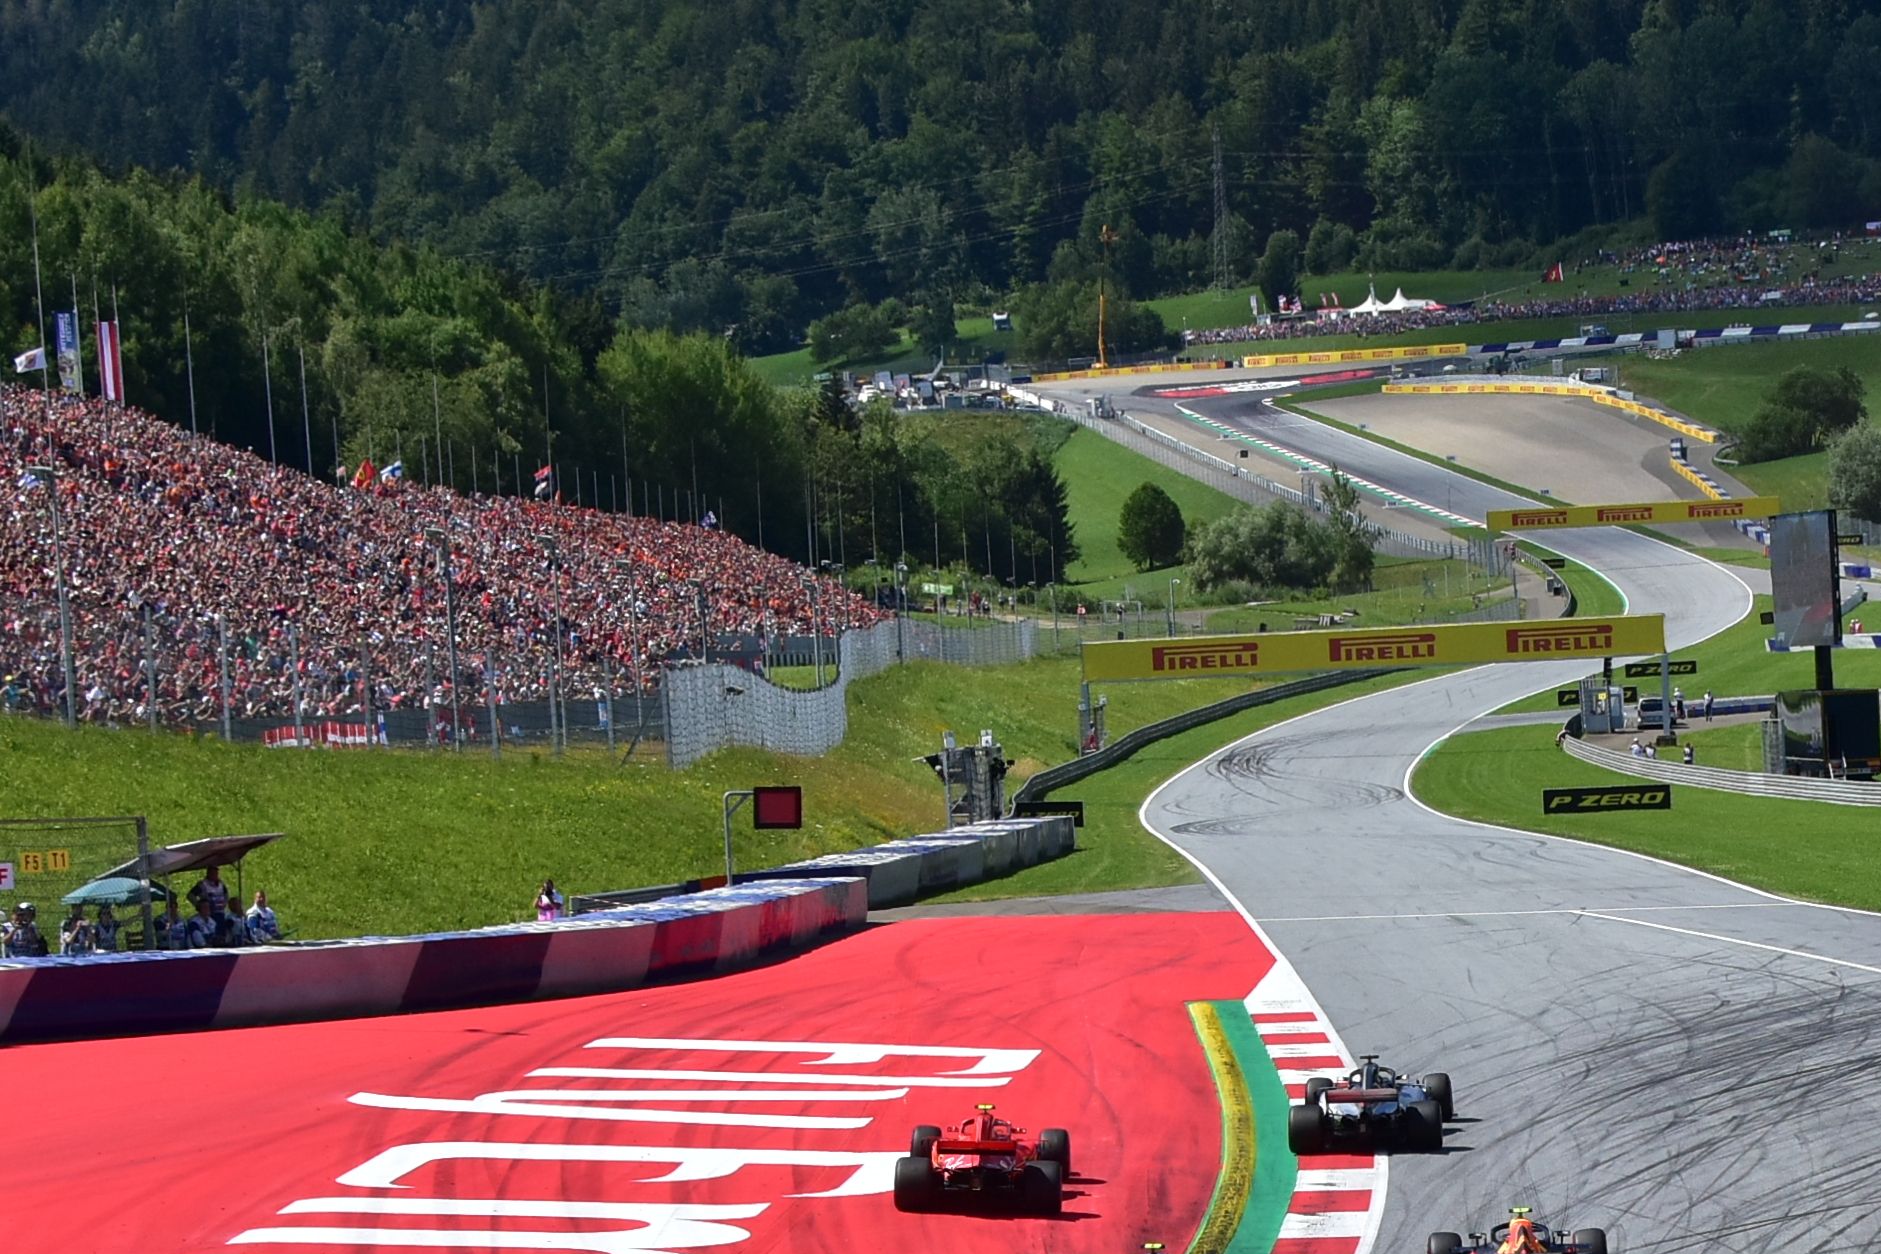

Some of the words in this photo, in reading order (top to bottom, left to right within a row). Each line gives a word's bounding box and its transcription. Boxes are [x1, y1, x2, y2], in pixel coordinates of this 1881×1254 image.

[1597, 507, 1653, 522] PIRELLI
[1688, 503, 1743, 517] PIRELLI
[1512, 511, 1567, 526] PIRELLI
[1506, 625, 1613, 653] PIRELLI
[1329, 634, 1435, 662] PIRELLI
[1152, 643, 1258, 671] PIRELLI
[1550, 796, 1572, 809] P
[1578, 792, 1665, 806] ZERO
[24, 855, 39, 870] F5
[52, 853, 66, 867] T1
